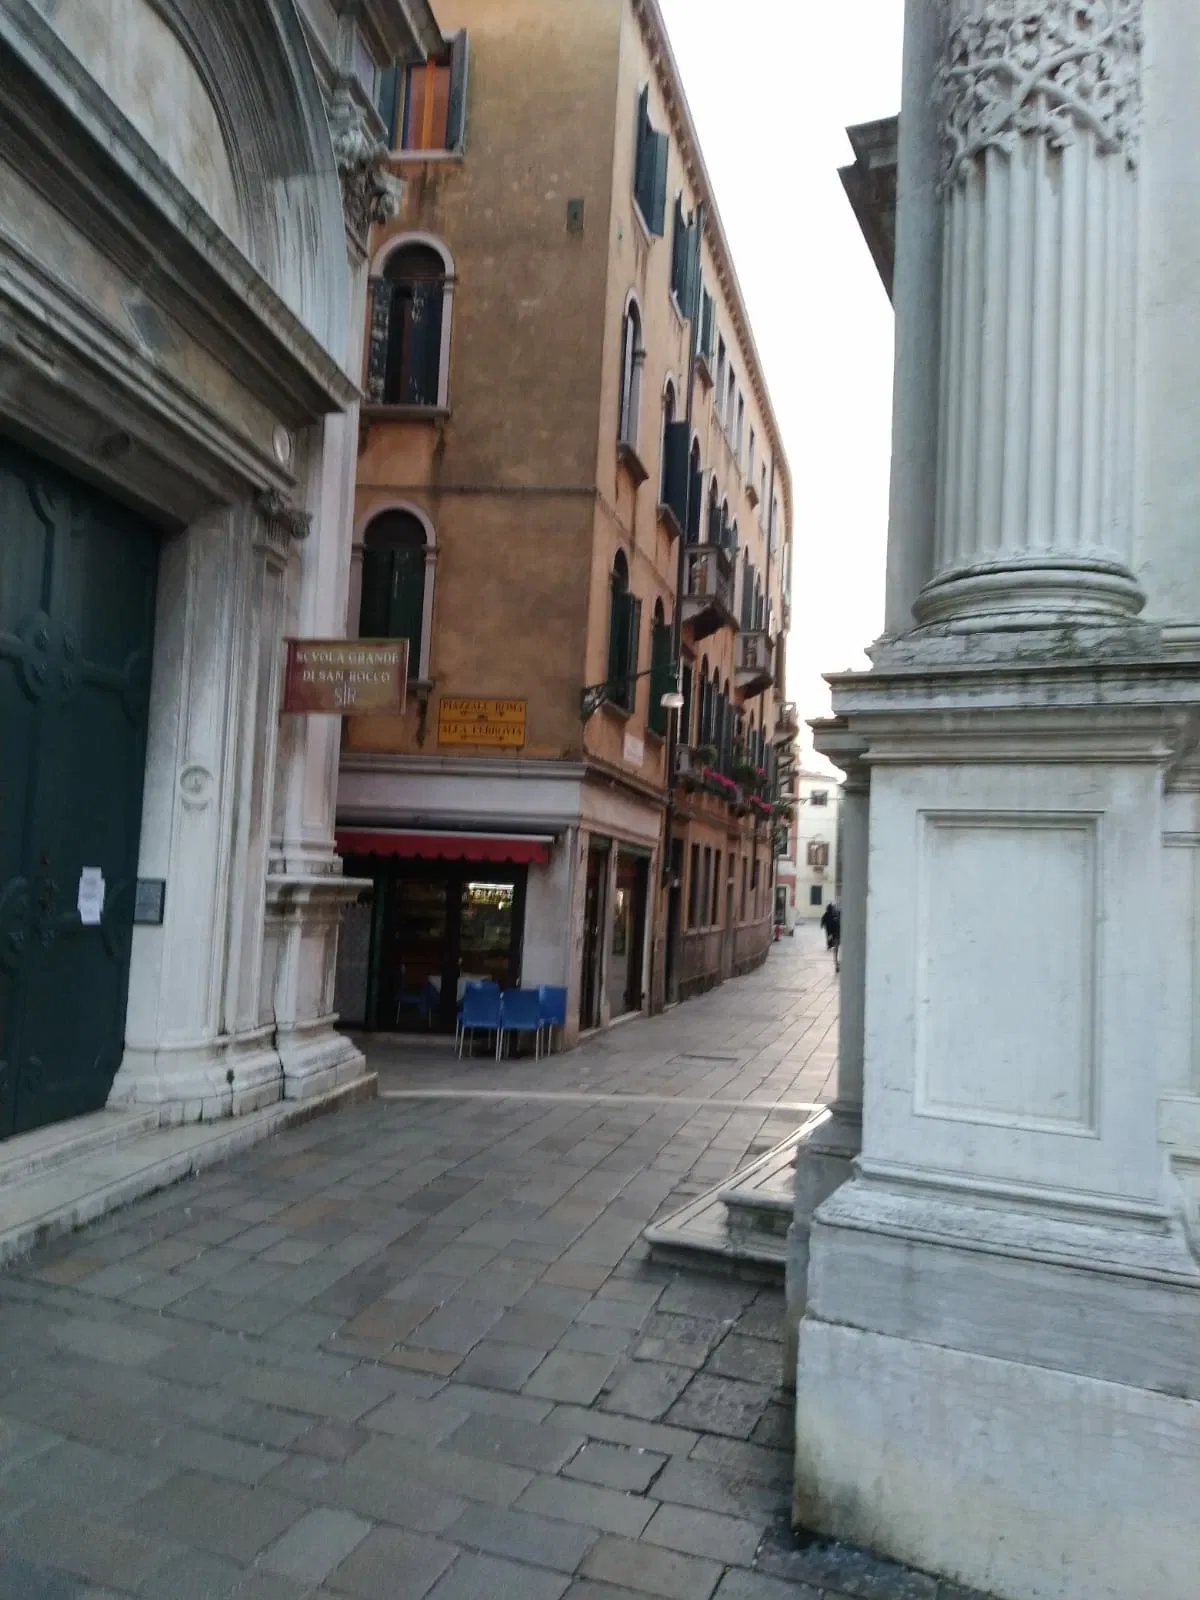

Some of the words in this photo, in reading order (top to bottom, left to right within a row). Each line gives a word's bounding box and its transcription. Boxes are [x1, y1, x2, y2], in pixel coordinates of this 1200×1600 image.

[348, 651, 399, 665] GRANDE
[303, 669, 315, 682] DI
[319, 670, 344, 682] SAN
[349, 671, 391, 684] ROCCO
[496, 702, 523, 713] ROMA
